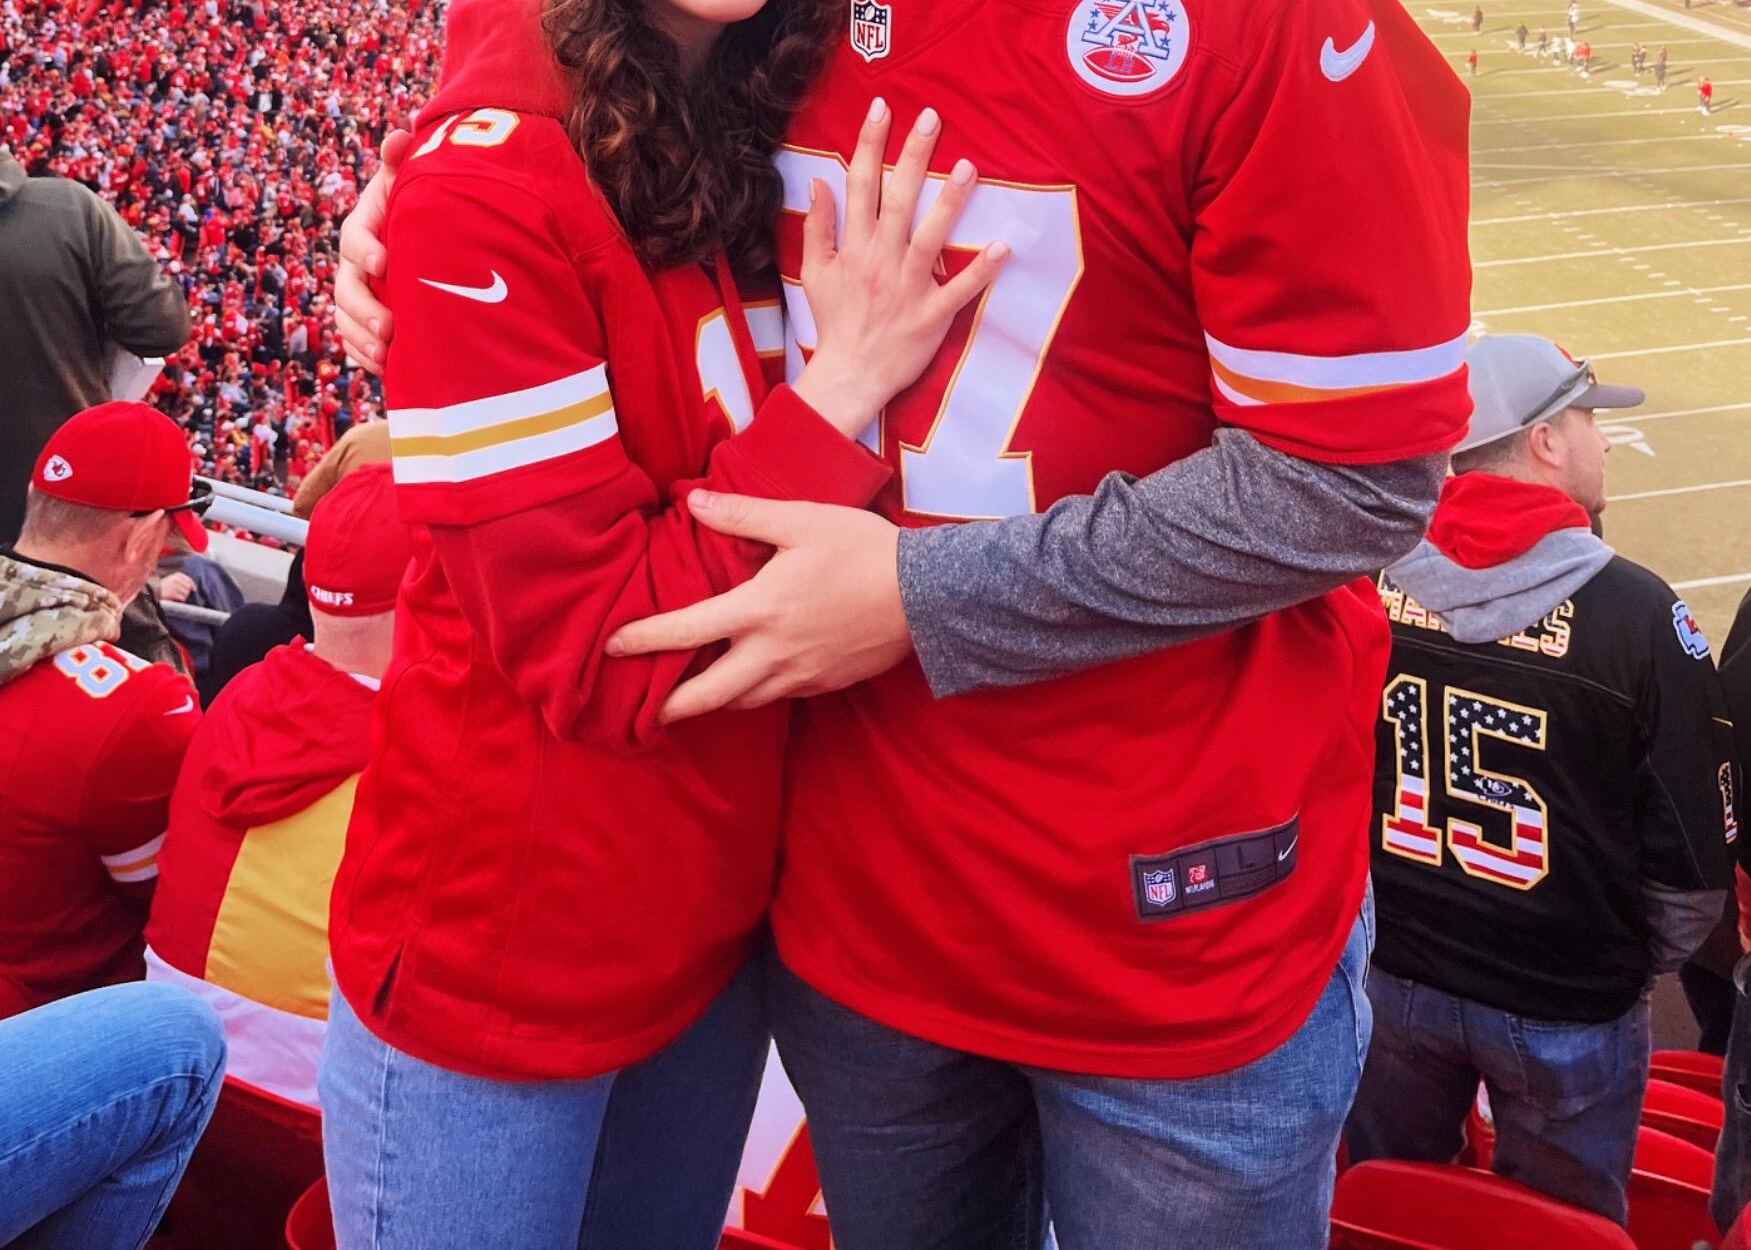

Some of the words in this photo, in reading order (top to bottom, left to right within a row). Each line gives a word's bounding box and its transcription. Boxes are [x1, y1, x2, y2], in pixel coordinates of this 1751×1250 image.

[856, 21, 884, 50] NFL
[1382, 673, 1549, 891] 15
[1150, 884, 1171, 899] NFL
